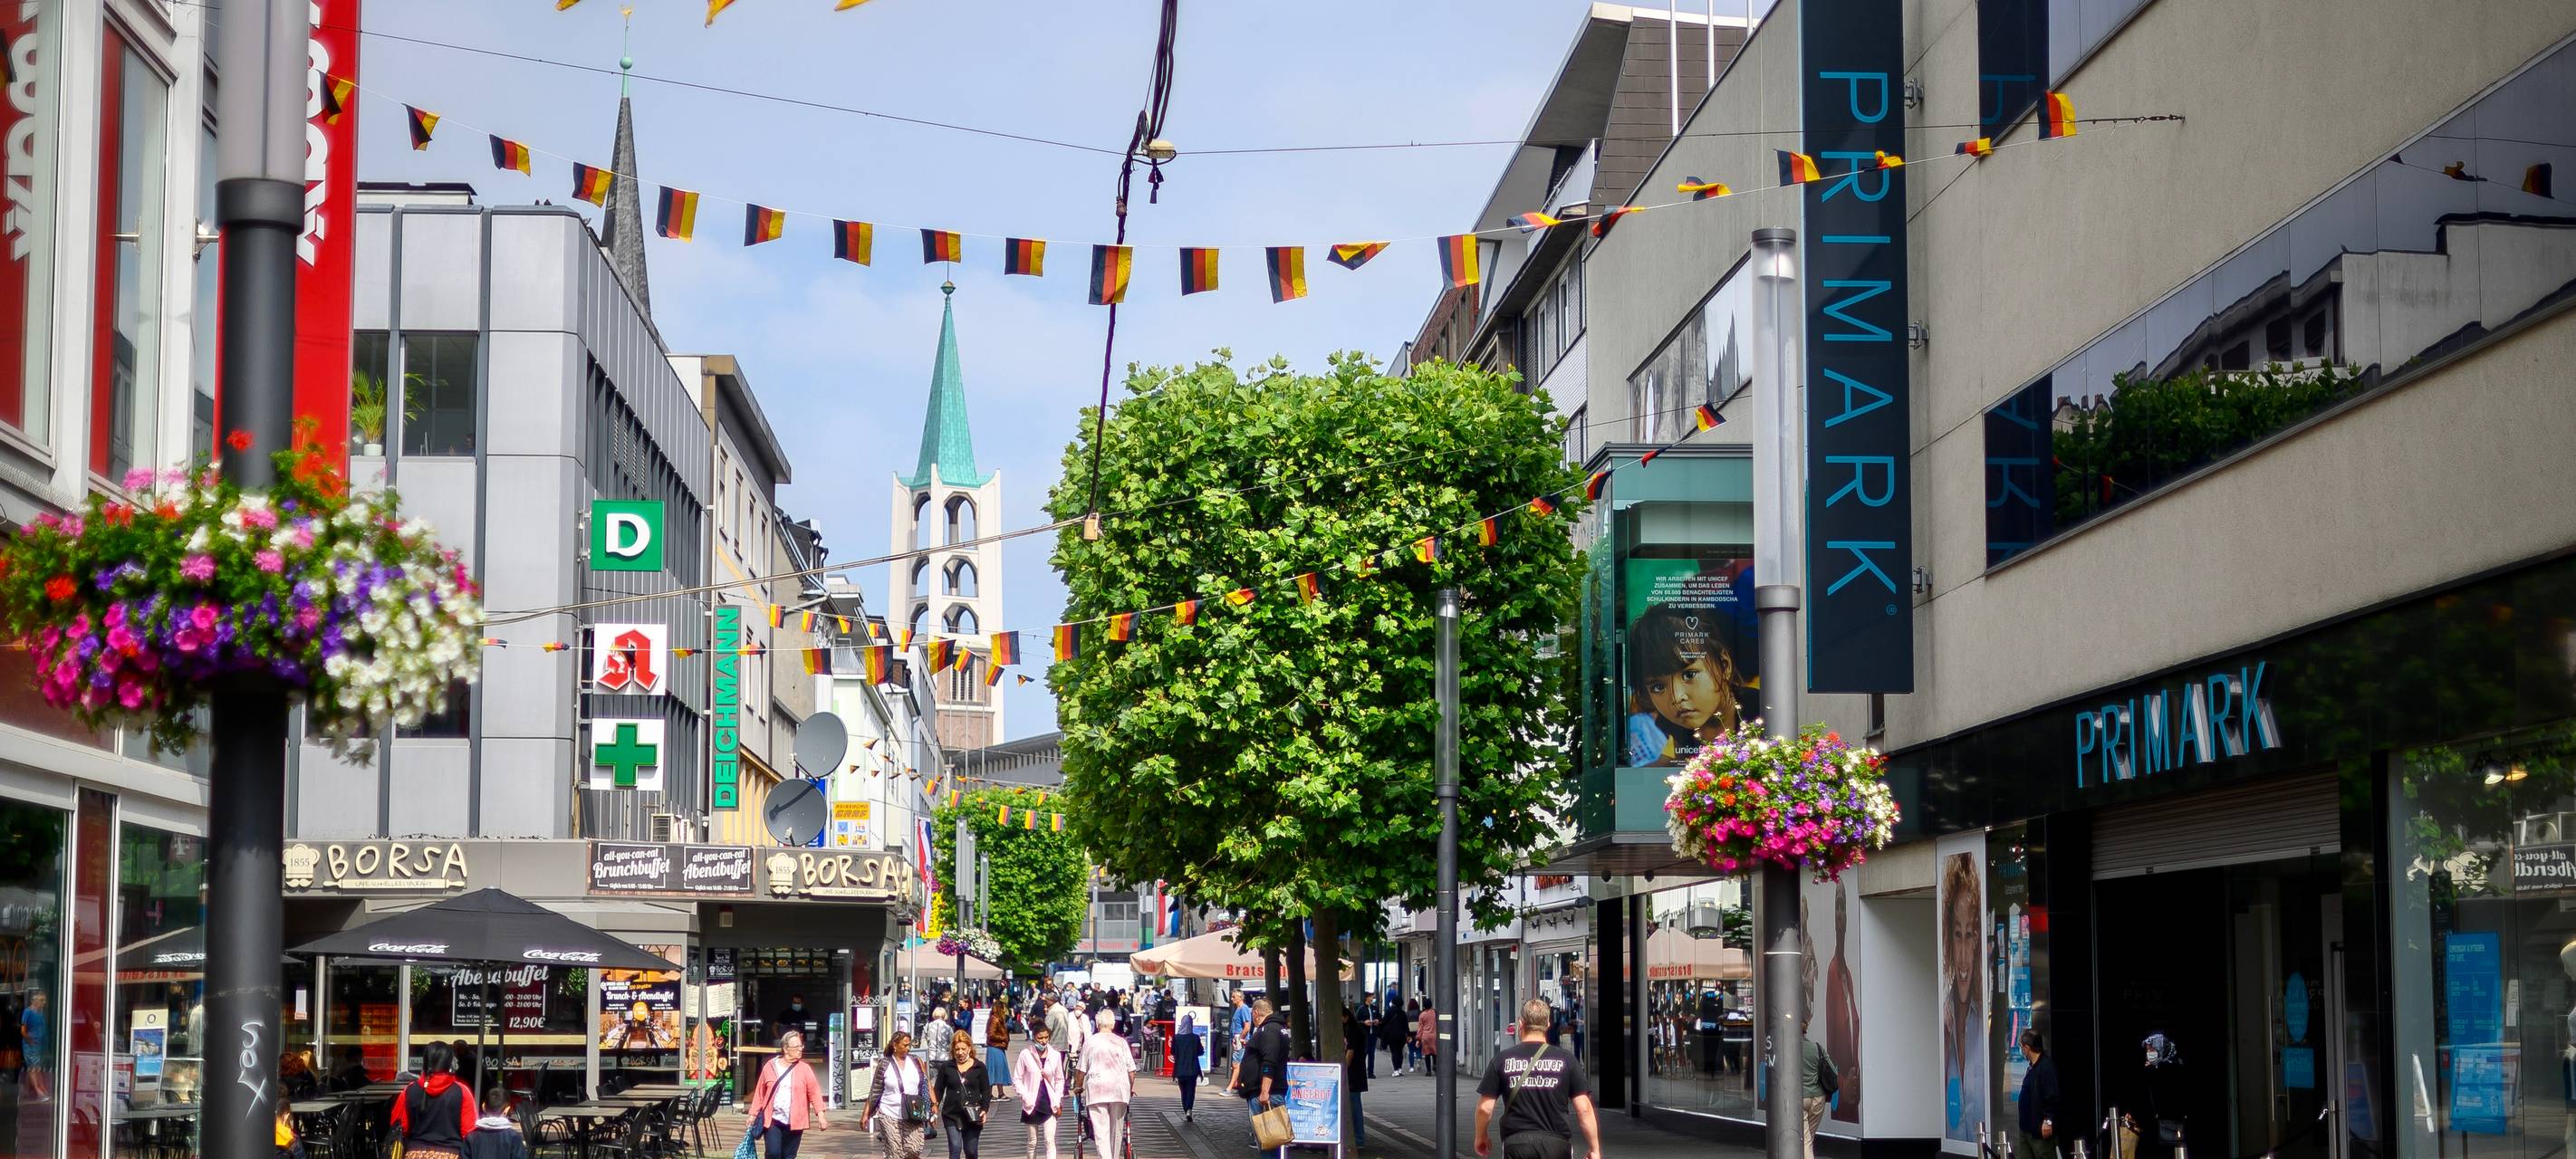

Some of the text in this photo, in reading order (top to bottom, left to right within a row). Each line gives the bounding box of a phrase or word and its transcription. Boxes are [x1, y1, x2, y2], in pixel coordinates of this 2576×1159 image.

[1819, 71, 1897, 598] PRIMARK
[715, 608, 739, 809] DEICHMANN
[2075, 661, 2270, 789] PRIMARK
[289, 857, 311, 867] 1855
[327, 843, 468, 879] BORSA
[603, 848, 659, 864] all-you-can-eat
[692, 849, 746, 865] all-you-can-eat
[592, 857, 671, 880] Brunchbuffet
[682, 859, 752, 882] Abendbuffet
[800, 853, 900, 890] BORSA
[605, 991, 675, 1002] Brunch- & Abendbuffet
[508, 1016, 546, 1029] 12,90€
[485, 1056, 520, 1068] BOSA
[1504, 1058, 1529, 1073] Blue
[1291, 1087, 1332, 1102] ANGEBOT
